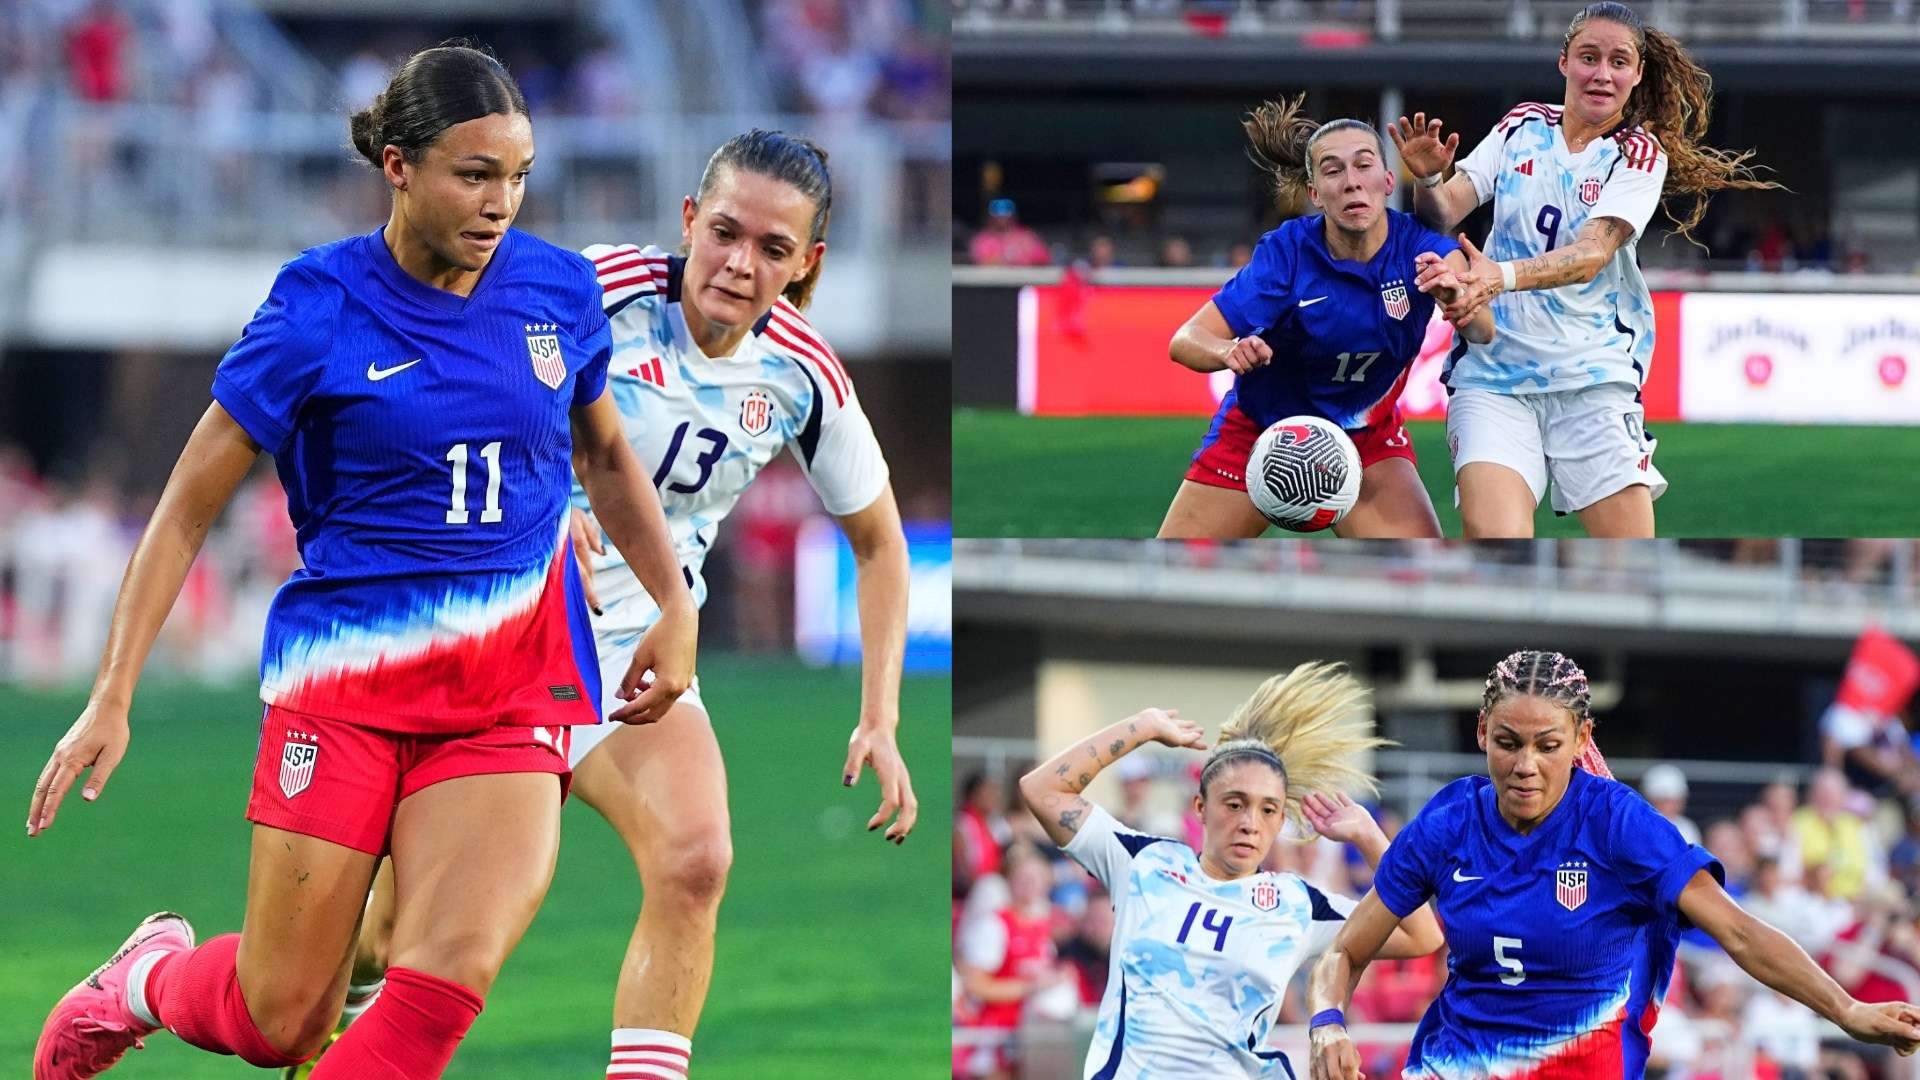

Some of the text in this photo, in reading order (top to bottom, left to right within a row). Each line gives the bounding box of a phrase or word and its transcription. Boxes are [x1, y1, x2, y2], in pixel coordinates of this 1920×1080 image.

[1583, 183, 1600, 202] CR
[1536, 204, 1562, 253] 9
[1384, 287, 1406, 302] USA
[529, 338, 558, 359] USA
[1331, 351, 1381, 382] 17
[745, 399, 766, 430] CR
[652, 421, 729, 494] 13
[446, 441, 503, 524] 11
[285, 744, 315, 767] USA
[1558, 872, 1586, 888] USA
[1257, 887, 1275, 907] CR
[1176, 902, 1233, 952] 14
[1493, 935, 1526, 986] 5
